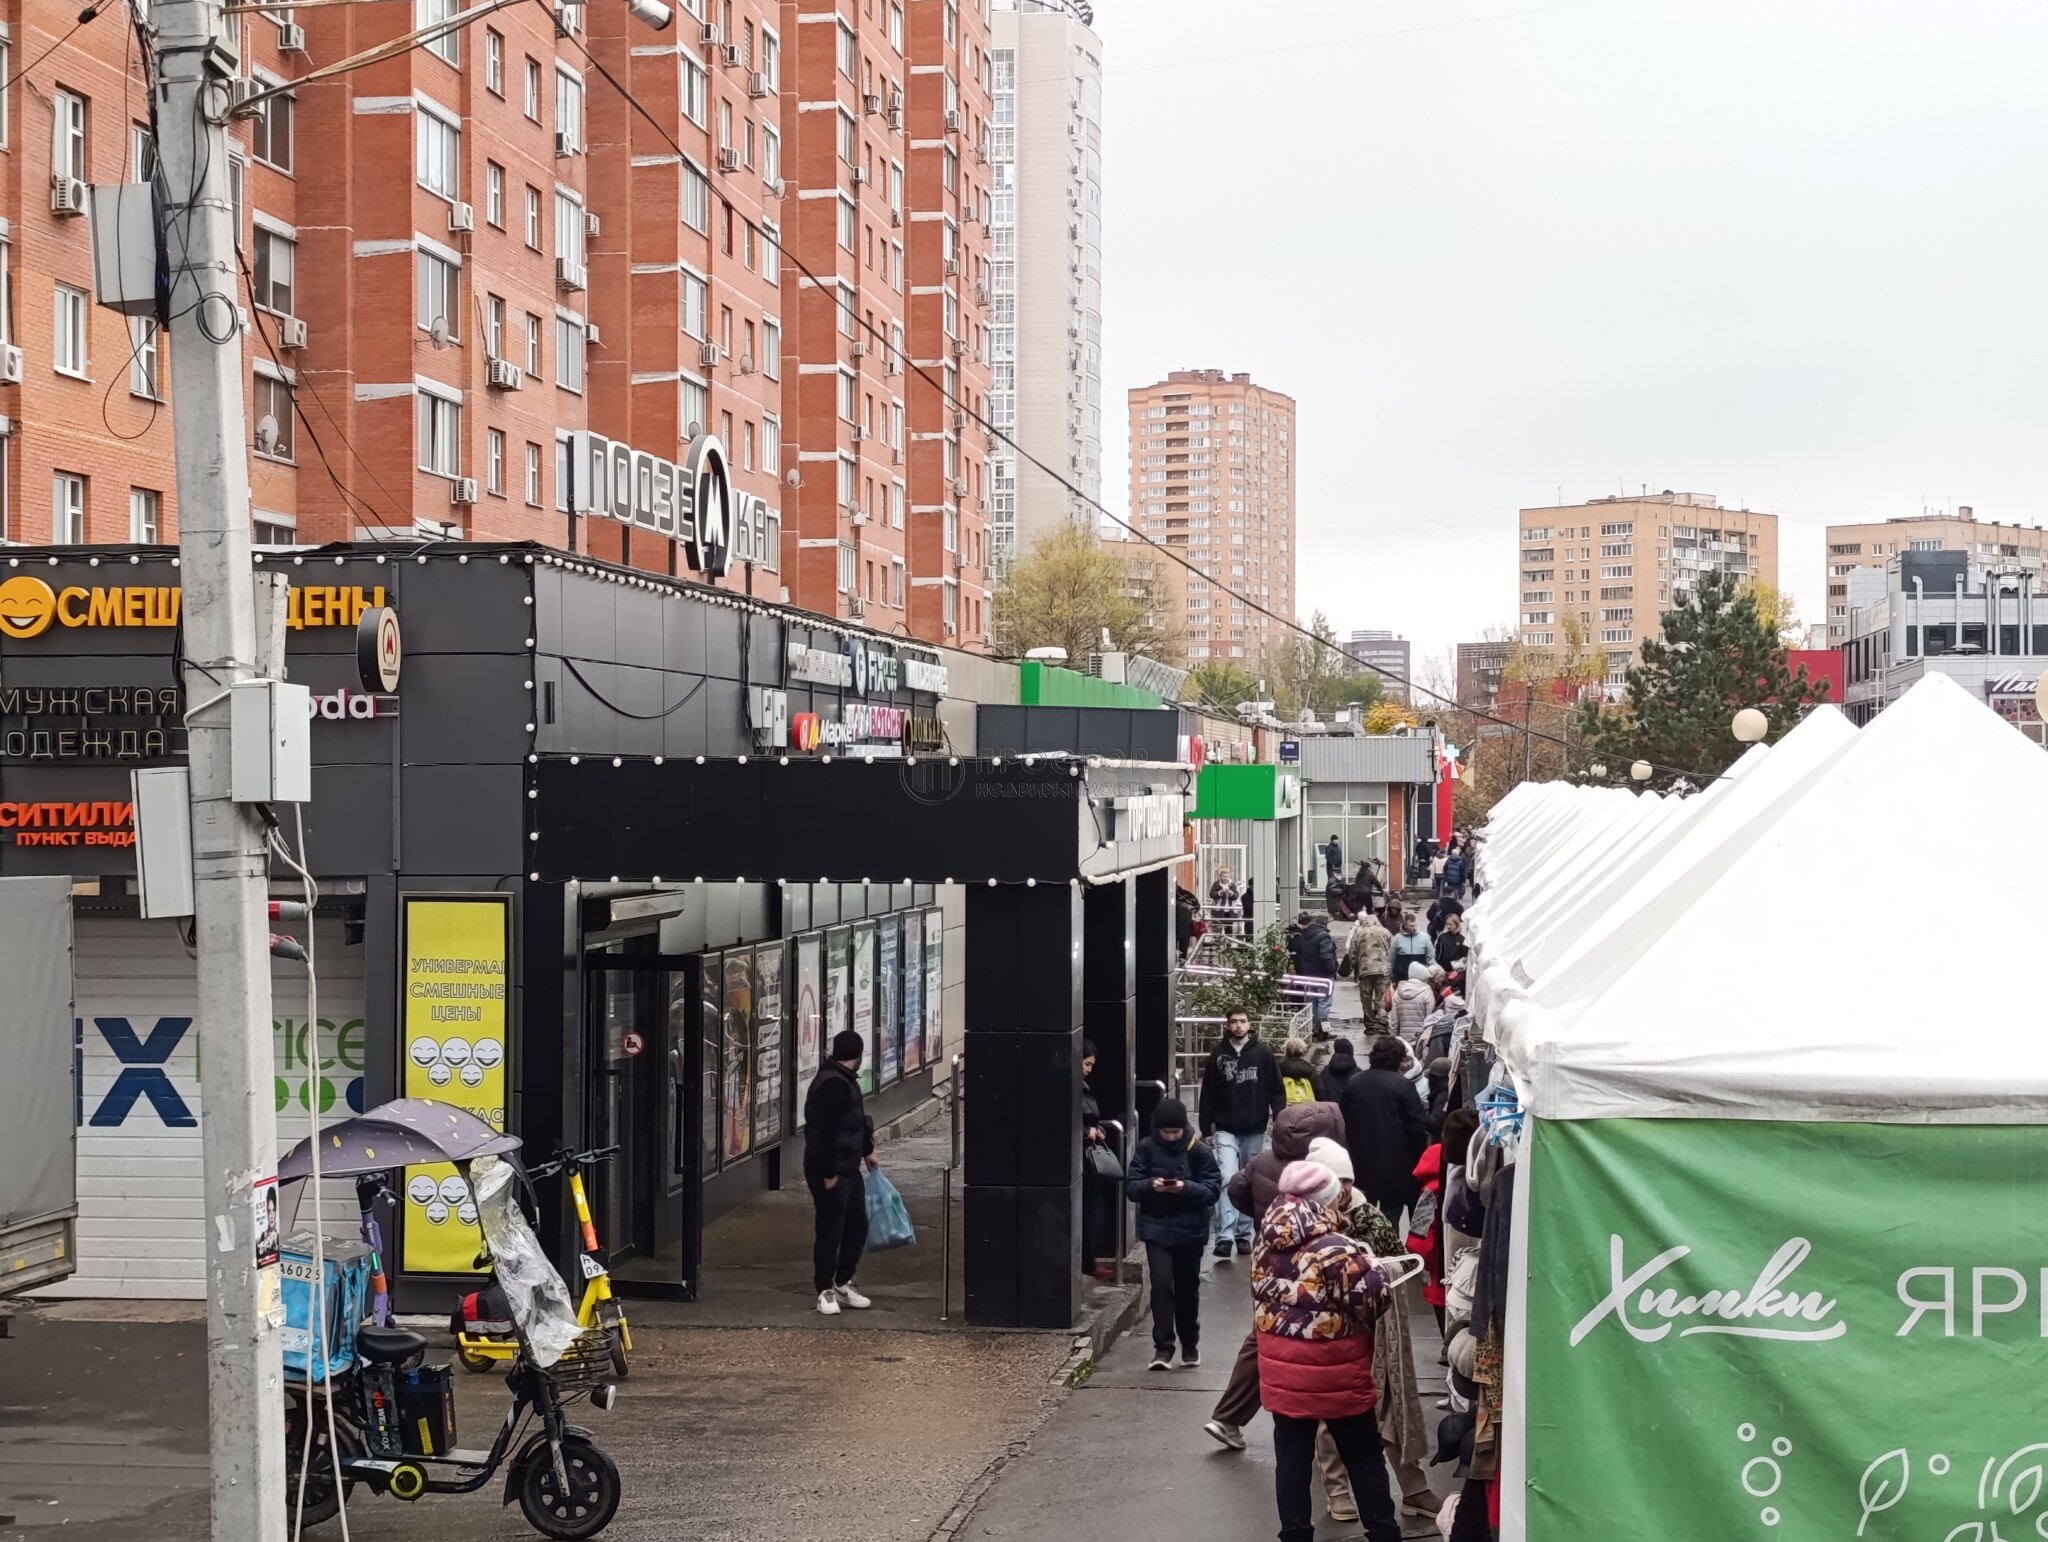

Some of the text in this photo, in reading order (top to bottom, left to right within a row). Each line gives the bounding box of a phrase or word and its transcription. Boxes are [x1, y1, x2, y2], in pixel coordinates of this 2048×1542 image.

[57, 586, 182, 627] СМЕШ
[0, 688, 178, 714] МУЖСКАЯ
[7, 730, 164, 760] ОДЕЖДА
[819, 719, 856, 748] Маркет
[0, 802, 134, 827] СИТИЛИ
[17, 832, 137, 847] ПУНКТ ВЫДА
[410, 982, 504, 999] СМЕШНЫЕ
[431, 1006, 482, 1022] ЦЕНЫ
[1570, 1234, 2048, 1346] Химки ЯР
